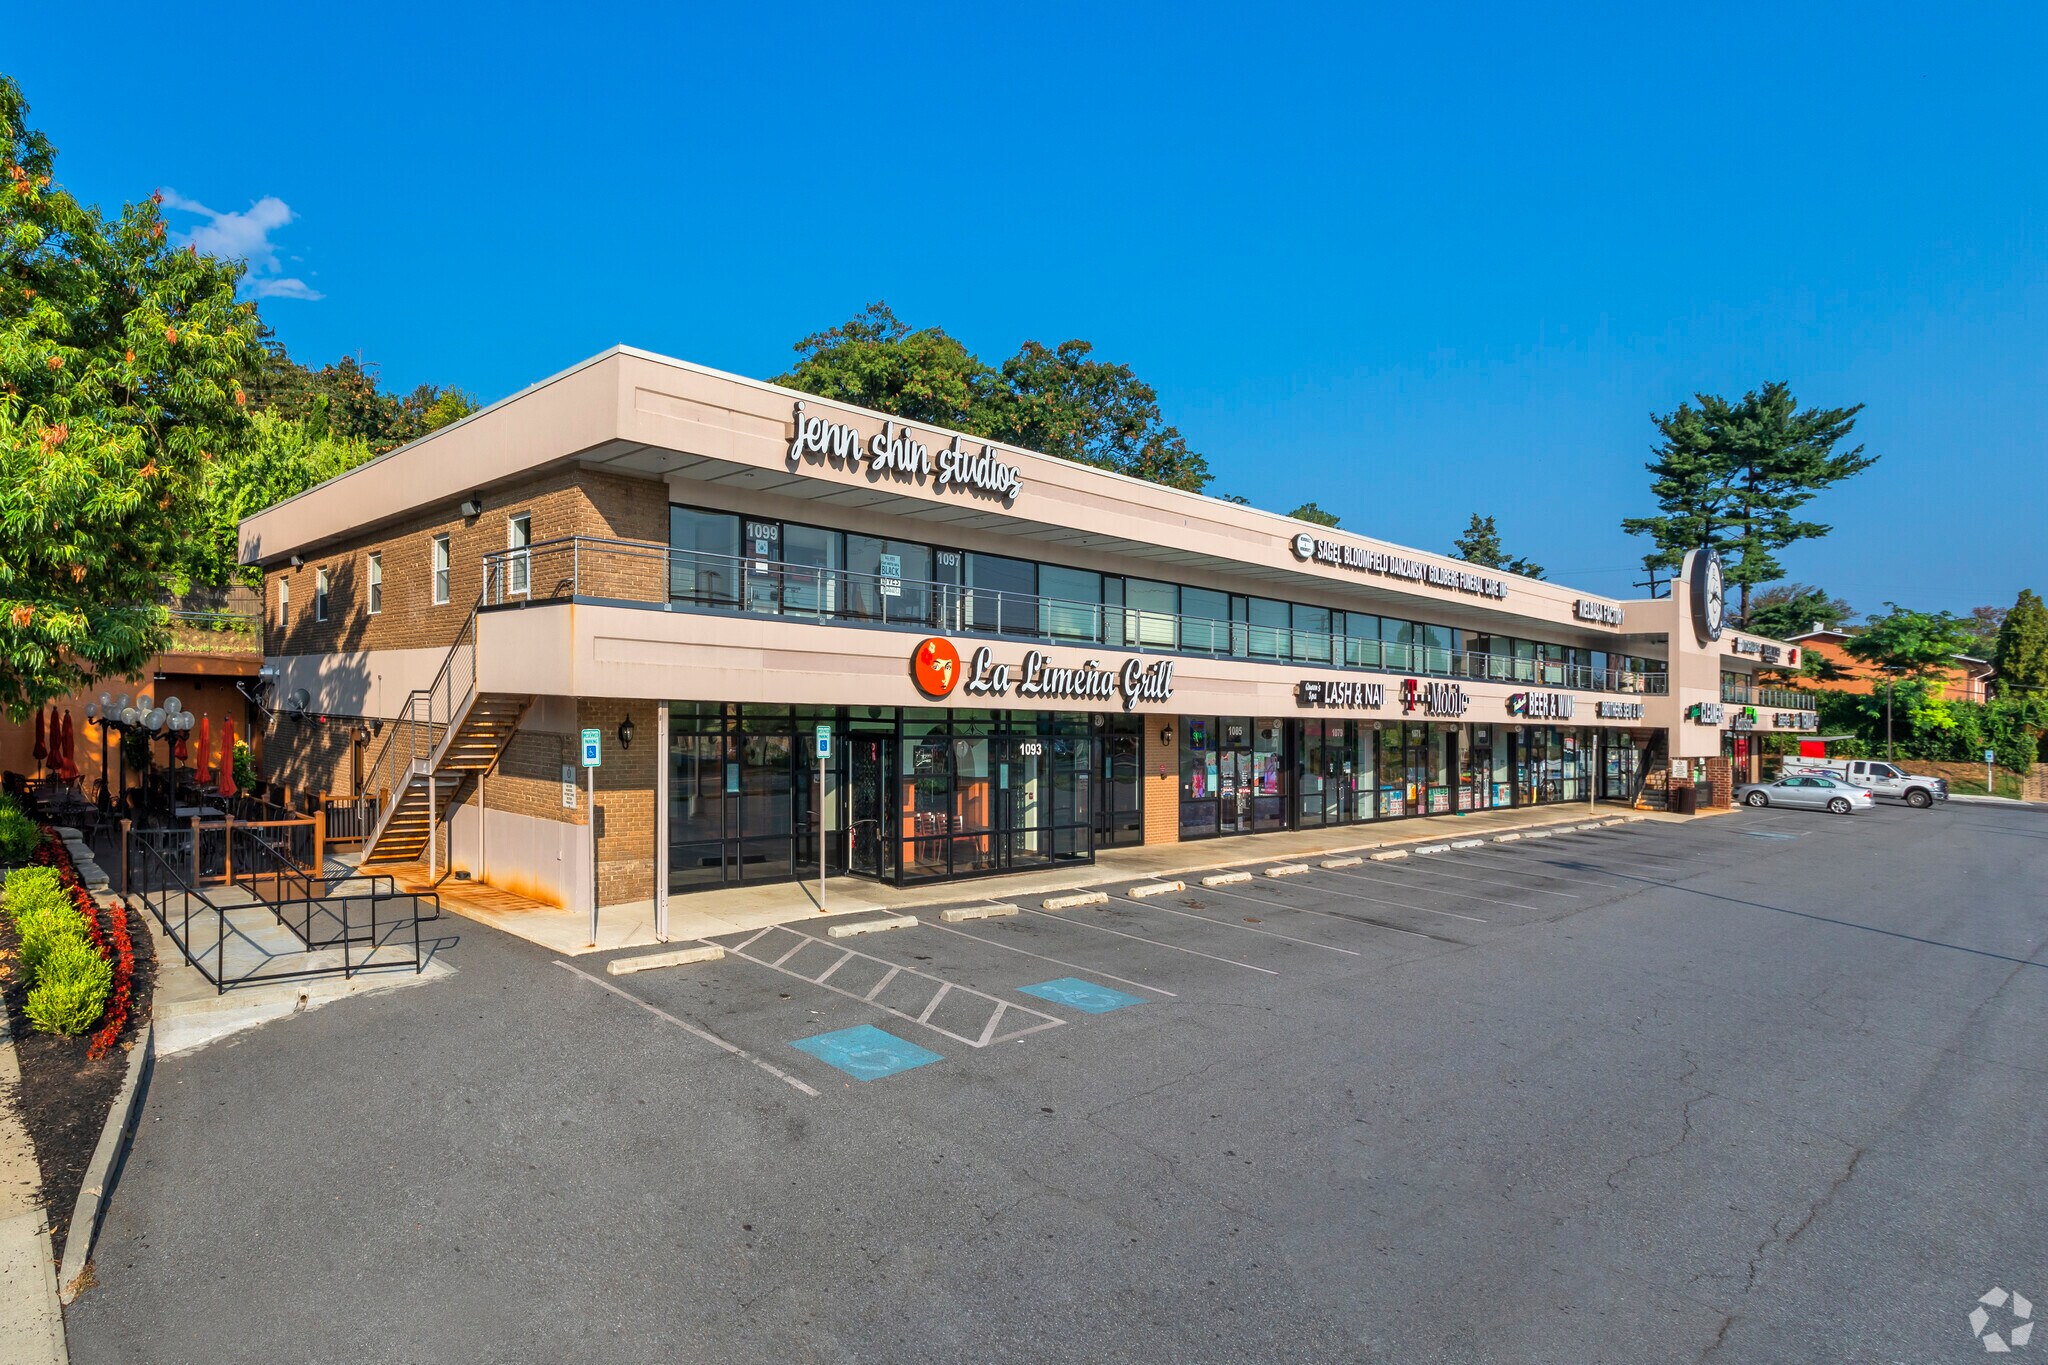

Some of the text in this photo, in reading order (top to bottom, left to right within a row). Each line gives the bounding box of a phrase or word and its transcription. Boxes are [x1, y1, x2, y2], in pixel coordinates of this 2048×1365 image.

[790, 401, 1024, 499] jenn shin studios
[747, 523, 778, 540] 1099
[937, 551, 961, 567] 1097
[1317, 540, 1342, 564] SAGEL
[1344, 545, 1388, 572] BLOOMFIELD
[1389, 555, 1428, 580] DANZANSKY
[1429, 565, 1459, 587] GOLDBERG
[1460, 572, 1484, 593] FUNERAL
[1485, 578, 1499, 596] CARE
[881, 565, 900, 577] BLACK
[969, 646, 1175, 709] La Limeña Grill
[1325, 681, 1388, 705] LASH & NAIL
[1529, 692, 1549, 716] BEER
[1550, 693, 1556, 717] &
[1558, 694, 1575, 717] WINE
[1228, 726, 1243, 736] 1085
[1019, 742, 1042, 756] 1093
